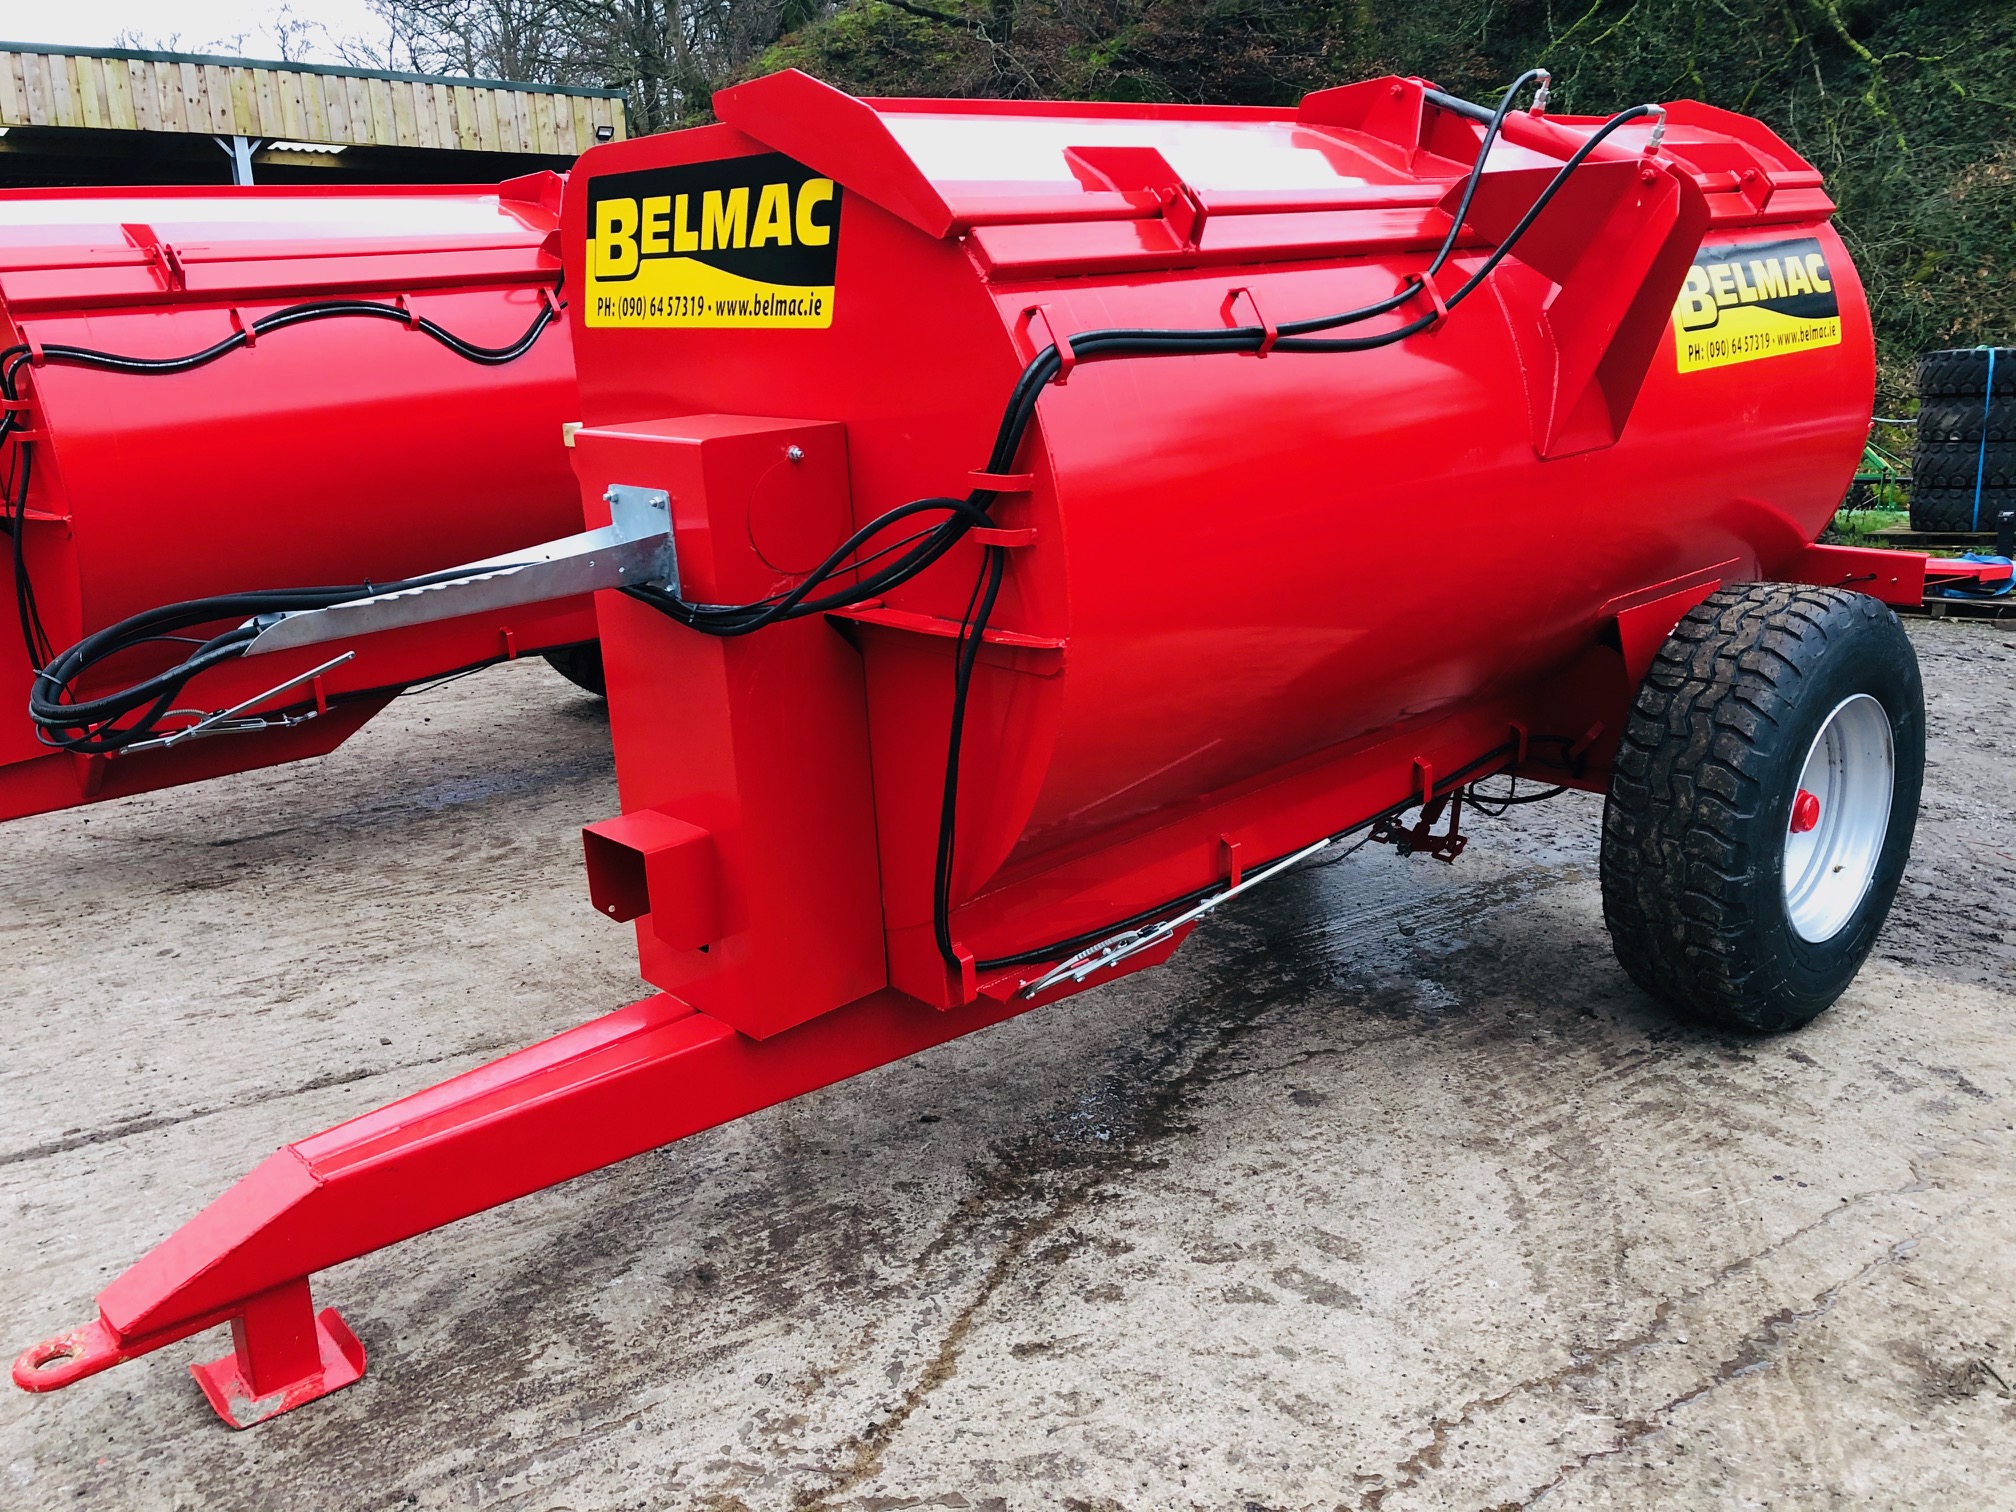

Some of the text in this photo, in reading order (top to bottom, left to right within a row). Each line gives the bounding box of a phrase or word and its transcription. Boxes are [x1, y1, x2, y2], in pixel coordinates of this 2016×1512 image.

[595, 178, 834, 277] BELMAC
[597, 297, 615, 317] PH:
[617, 297, 647, 320] (090)
[715, 292, 822, 317] www.belmac.ie
[1677, 253, 1832, 328] BELMAC
[1688, 344, 1705, 362] PH:
[1706, 338, 1729, 362] (090)
[1777, 321, 1836, 346] www.belmac.ie
